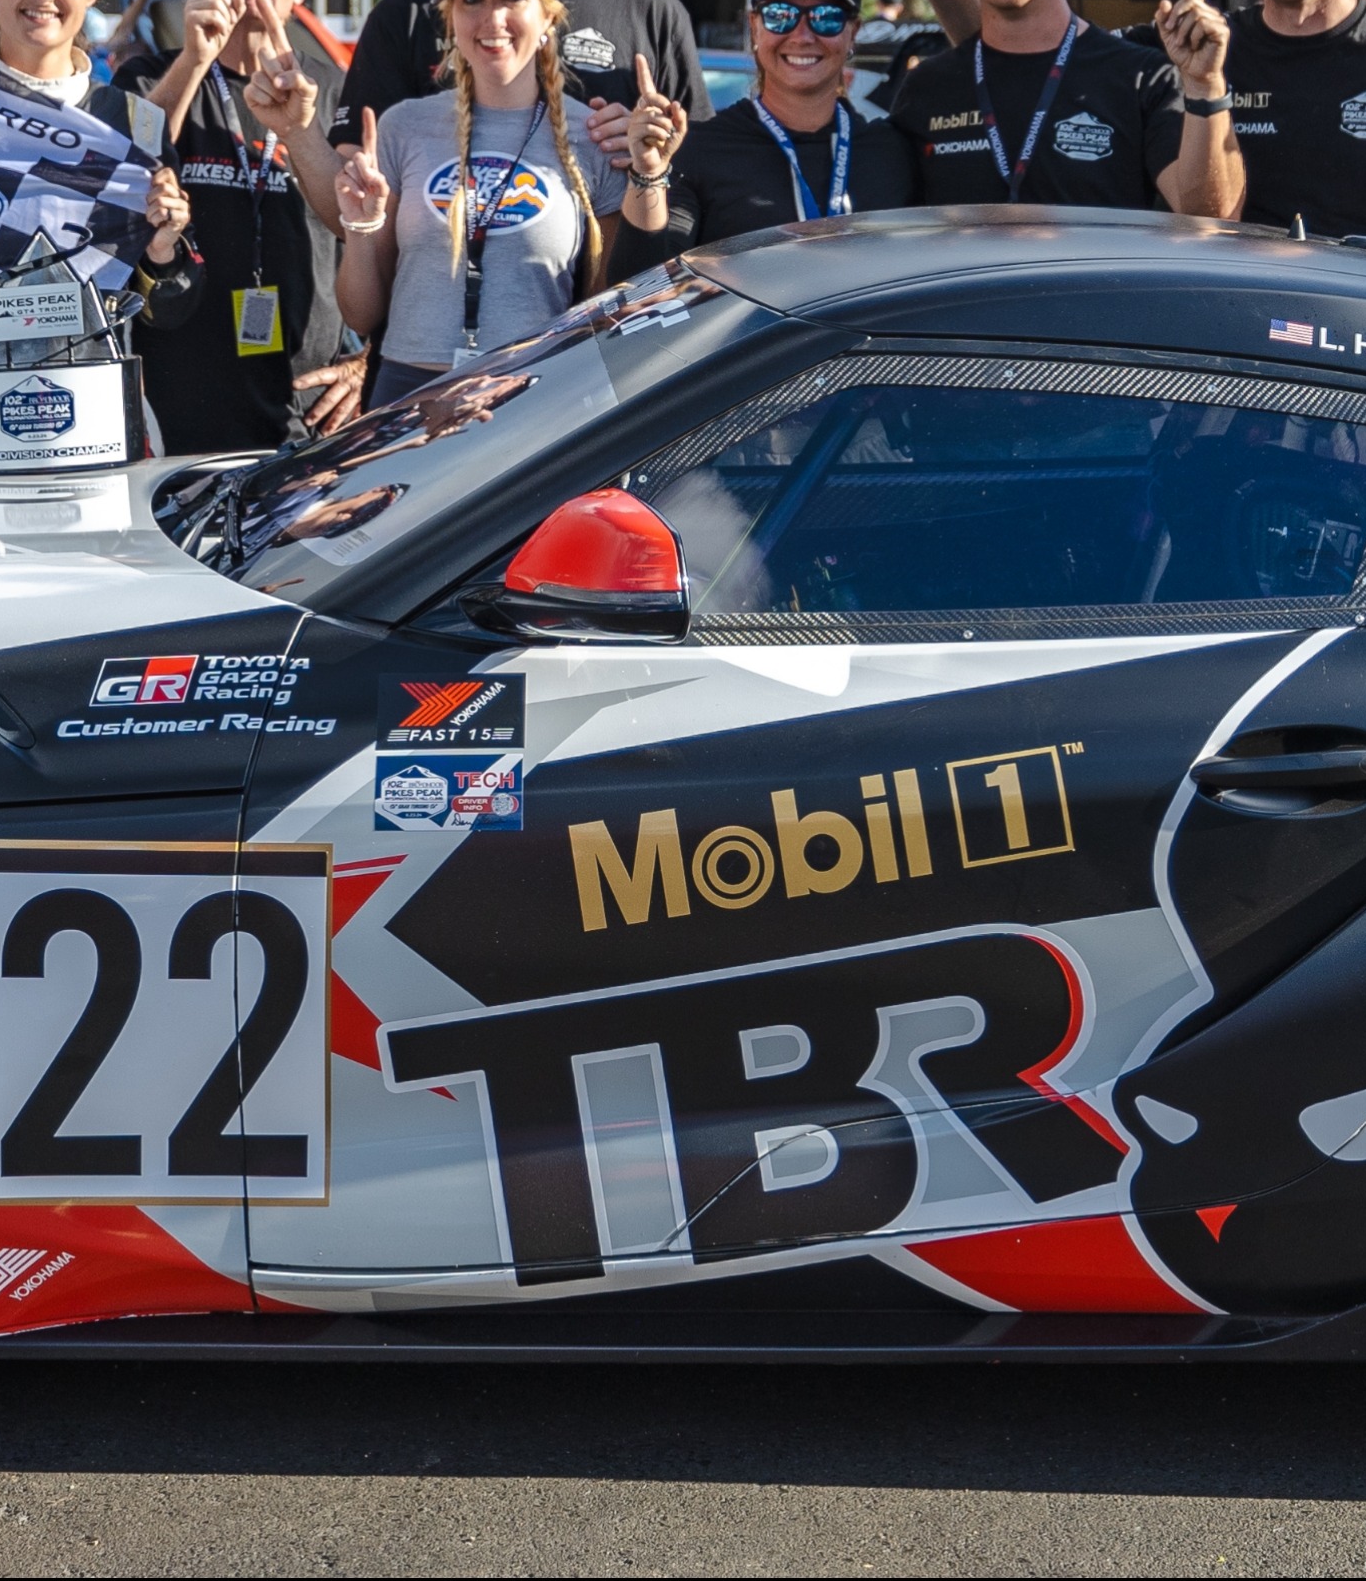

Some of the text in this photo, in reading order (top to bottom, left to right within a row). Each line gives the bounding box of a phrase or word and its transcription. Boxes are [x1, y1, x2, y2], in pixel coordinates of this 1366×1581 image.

[929, 112, 968, 132] Mobil
[1020, 110, 1046, 161] YOKOHAMA
[933, 139, 991, 155] YOKOHAMA
[988, 125, 1011, 177] YOKOHAMA
[180, 163, 236, 181] PIKES
[447, 164, 510, 184] PKES
[432, 177, 501, 199] PEK
[478, 183, 508, 227] YOKOHAMA
[494, 211, 525, 223] CLIMB
[37, 293, 77, 305] PEAK
[16, 304, 78, 316] GT4 TROPHY
[35, 315, 79, 324] YOKOHAMA
[1318, 327, 1345, 352] L.
[2, 403, 71, 416] PIKES PEAK
[0, 448, 55, 461] DIVISION
[57, 442, 122, 458] CHAMPION
[203, 654, 310, 670] TOYOTA
[96, 671, 298, 703] GR GAZOO
[193, 684, 292, 706] Racing
[450, 681, 506, 727] YOKOHAMA
[56, 713, 337, 738] Customer Racing
[409, 728, 492, 742] FAST 15
[453, 771, 515, 789] TECH
[385, 789, 443, 797] PIKES PEAK
[568, 768, 934, 933] Mobil
[1, 887, 310, 1178] 22
[378, 926, 1132, 1289] TBR
[8, 1249, 77, 1304] YOKOHAMA
